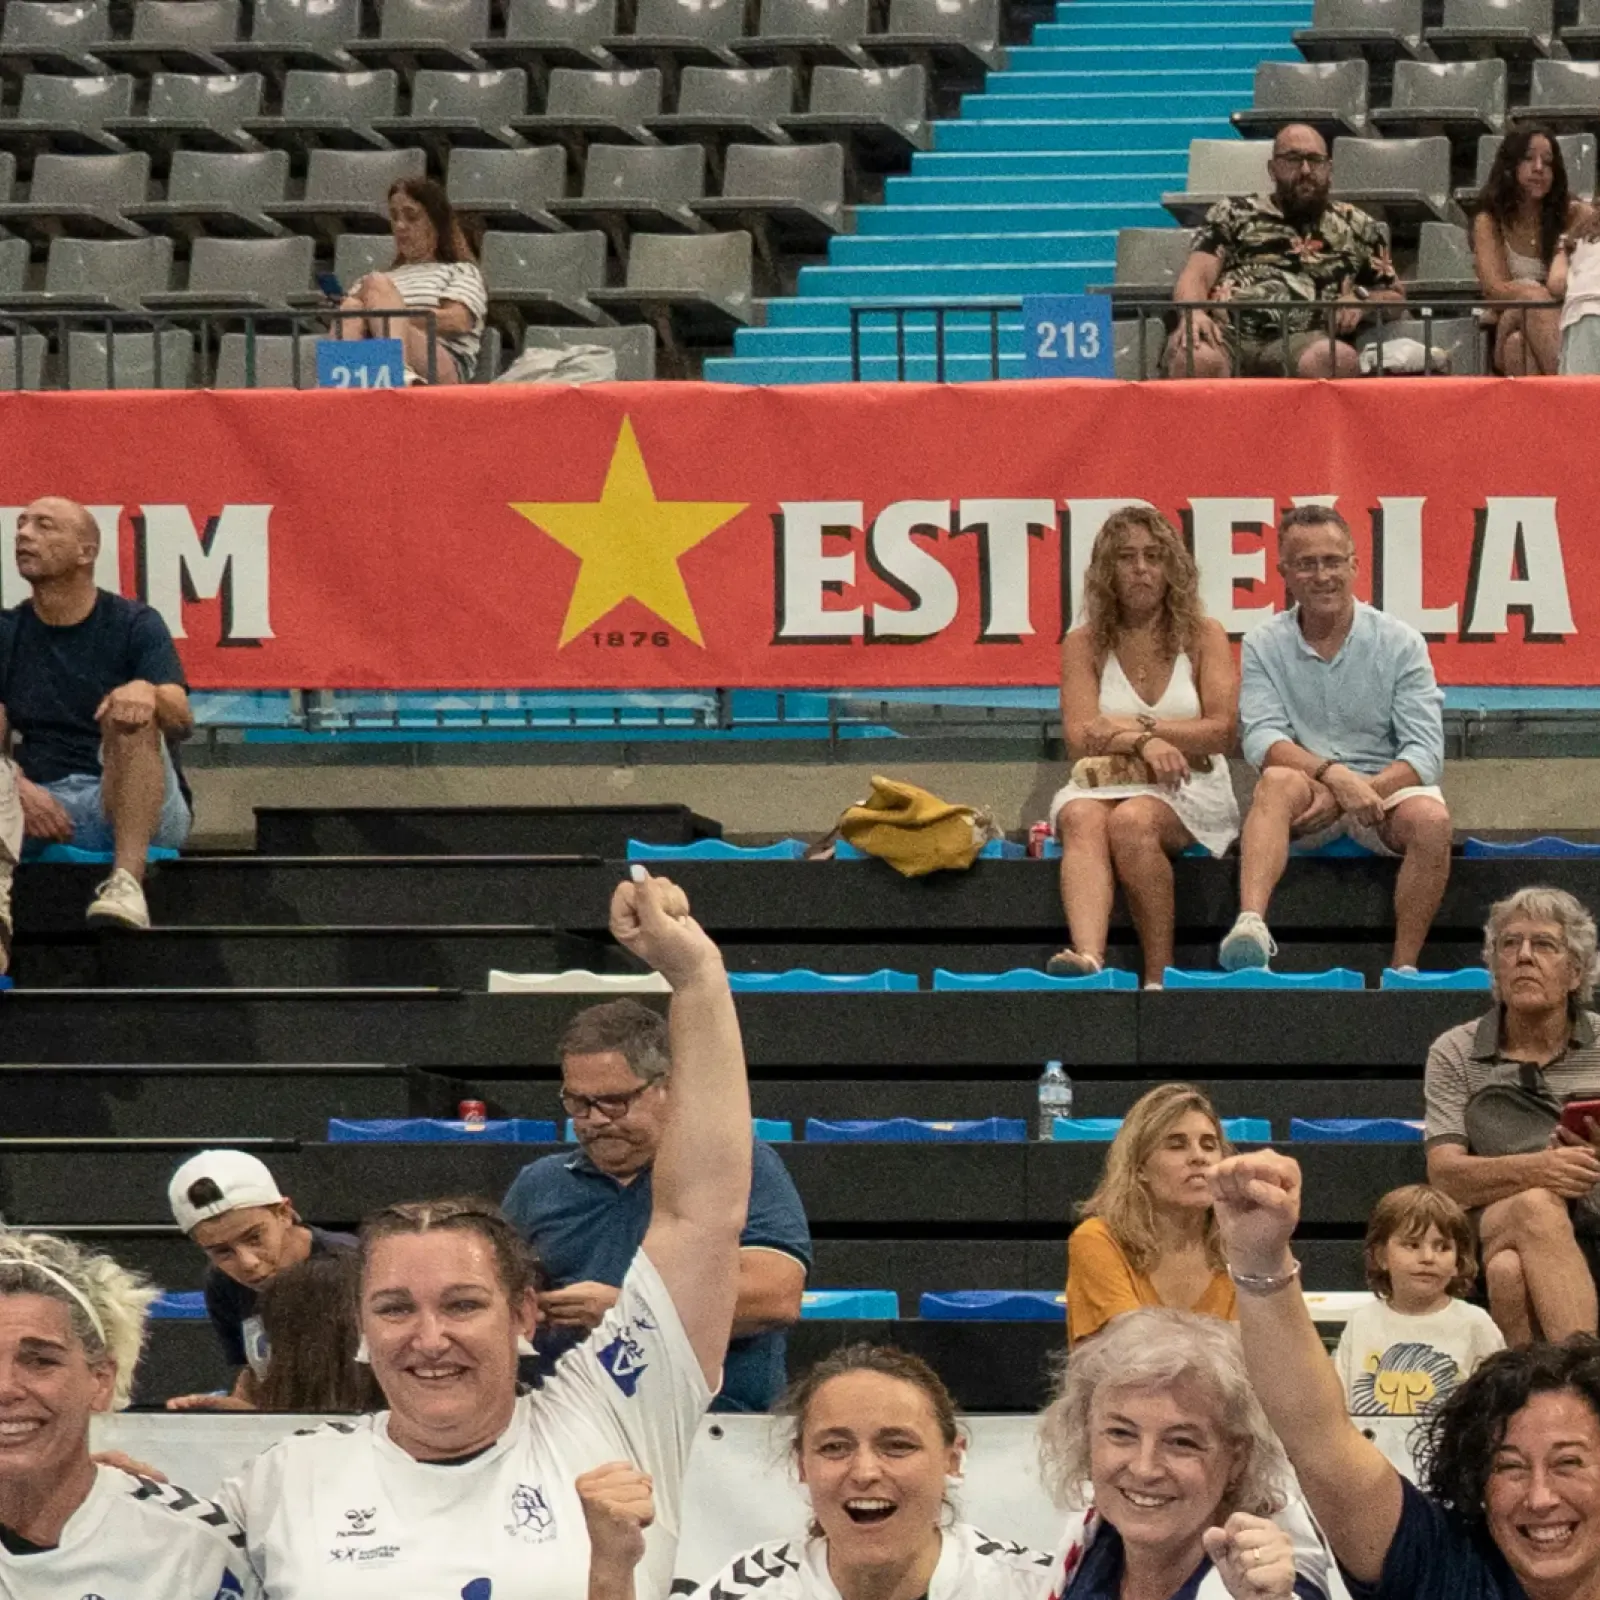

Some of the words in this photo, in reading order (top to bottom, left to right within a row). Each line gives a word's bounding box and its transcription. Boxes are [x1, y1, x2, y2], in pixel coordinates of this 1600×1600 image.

[1036, 320, 1100, 360] 213
[330, 365, 392, 388] 214
[592, 632, 670, 648] 1876
